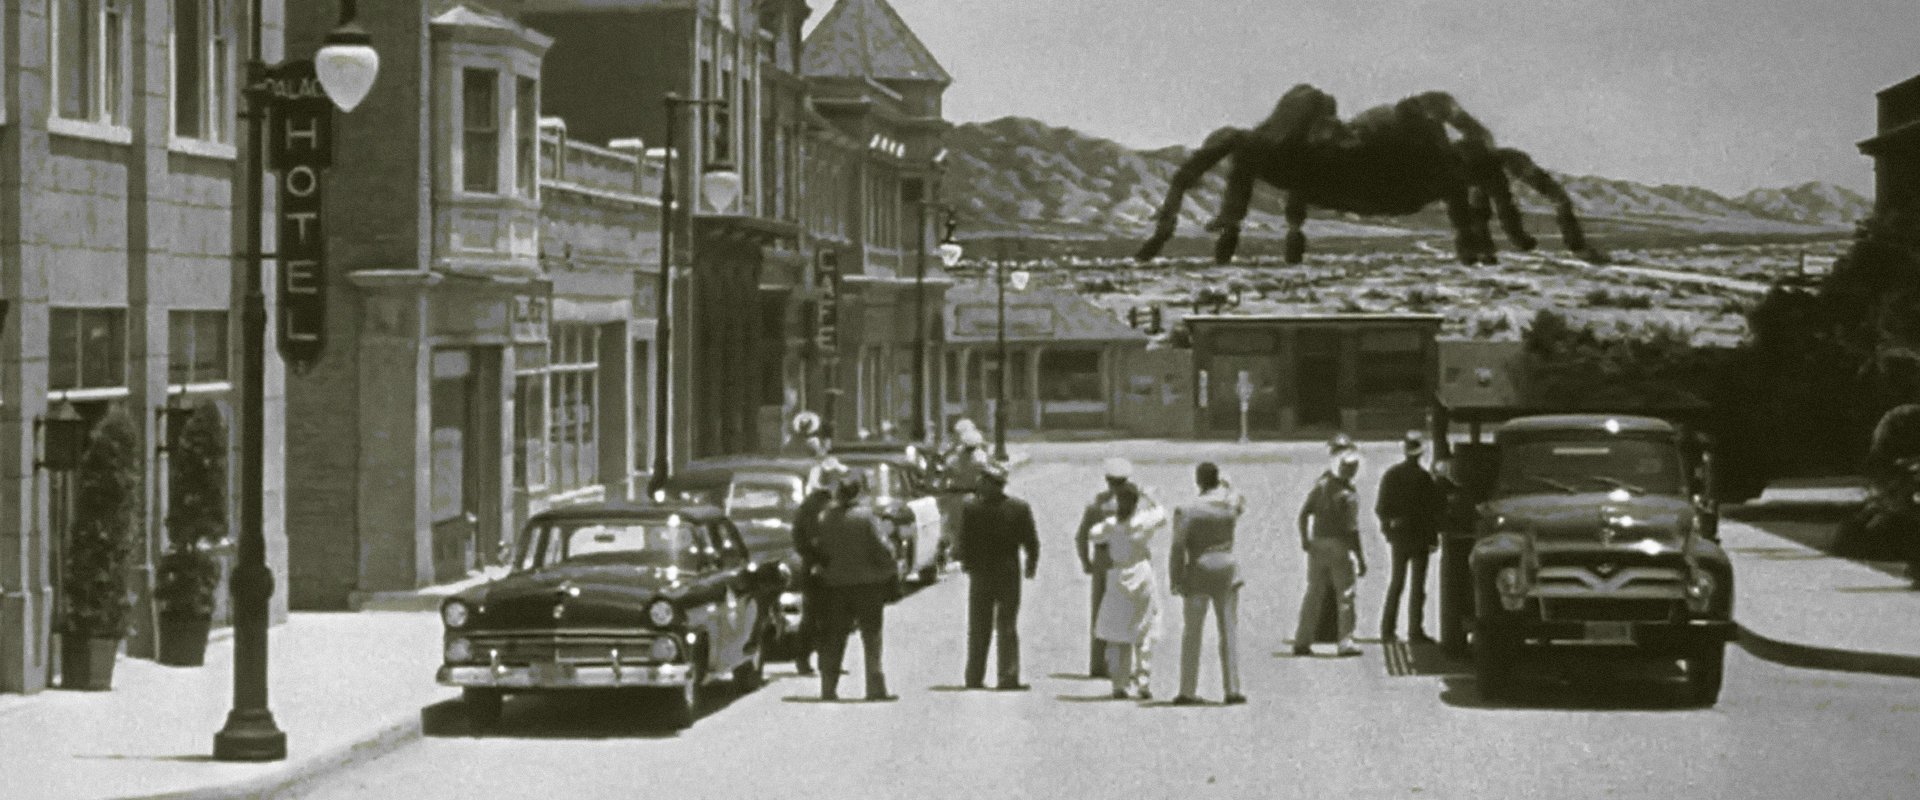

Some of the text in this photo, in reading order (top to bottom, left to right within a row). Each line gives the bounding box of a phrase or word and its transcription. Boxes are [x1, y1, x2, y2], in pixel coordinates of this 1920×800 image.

[265, 77, 322, 100] PALAC
[286, 118, 318, 341] HOTEL
[817, 249, 836, 350] CAFE
